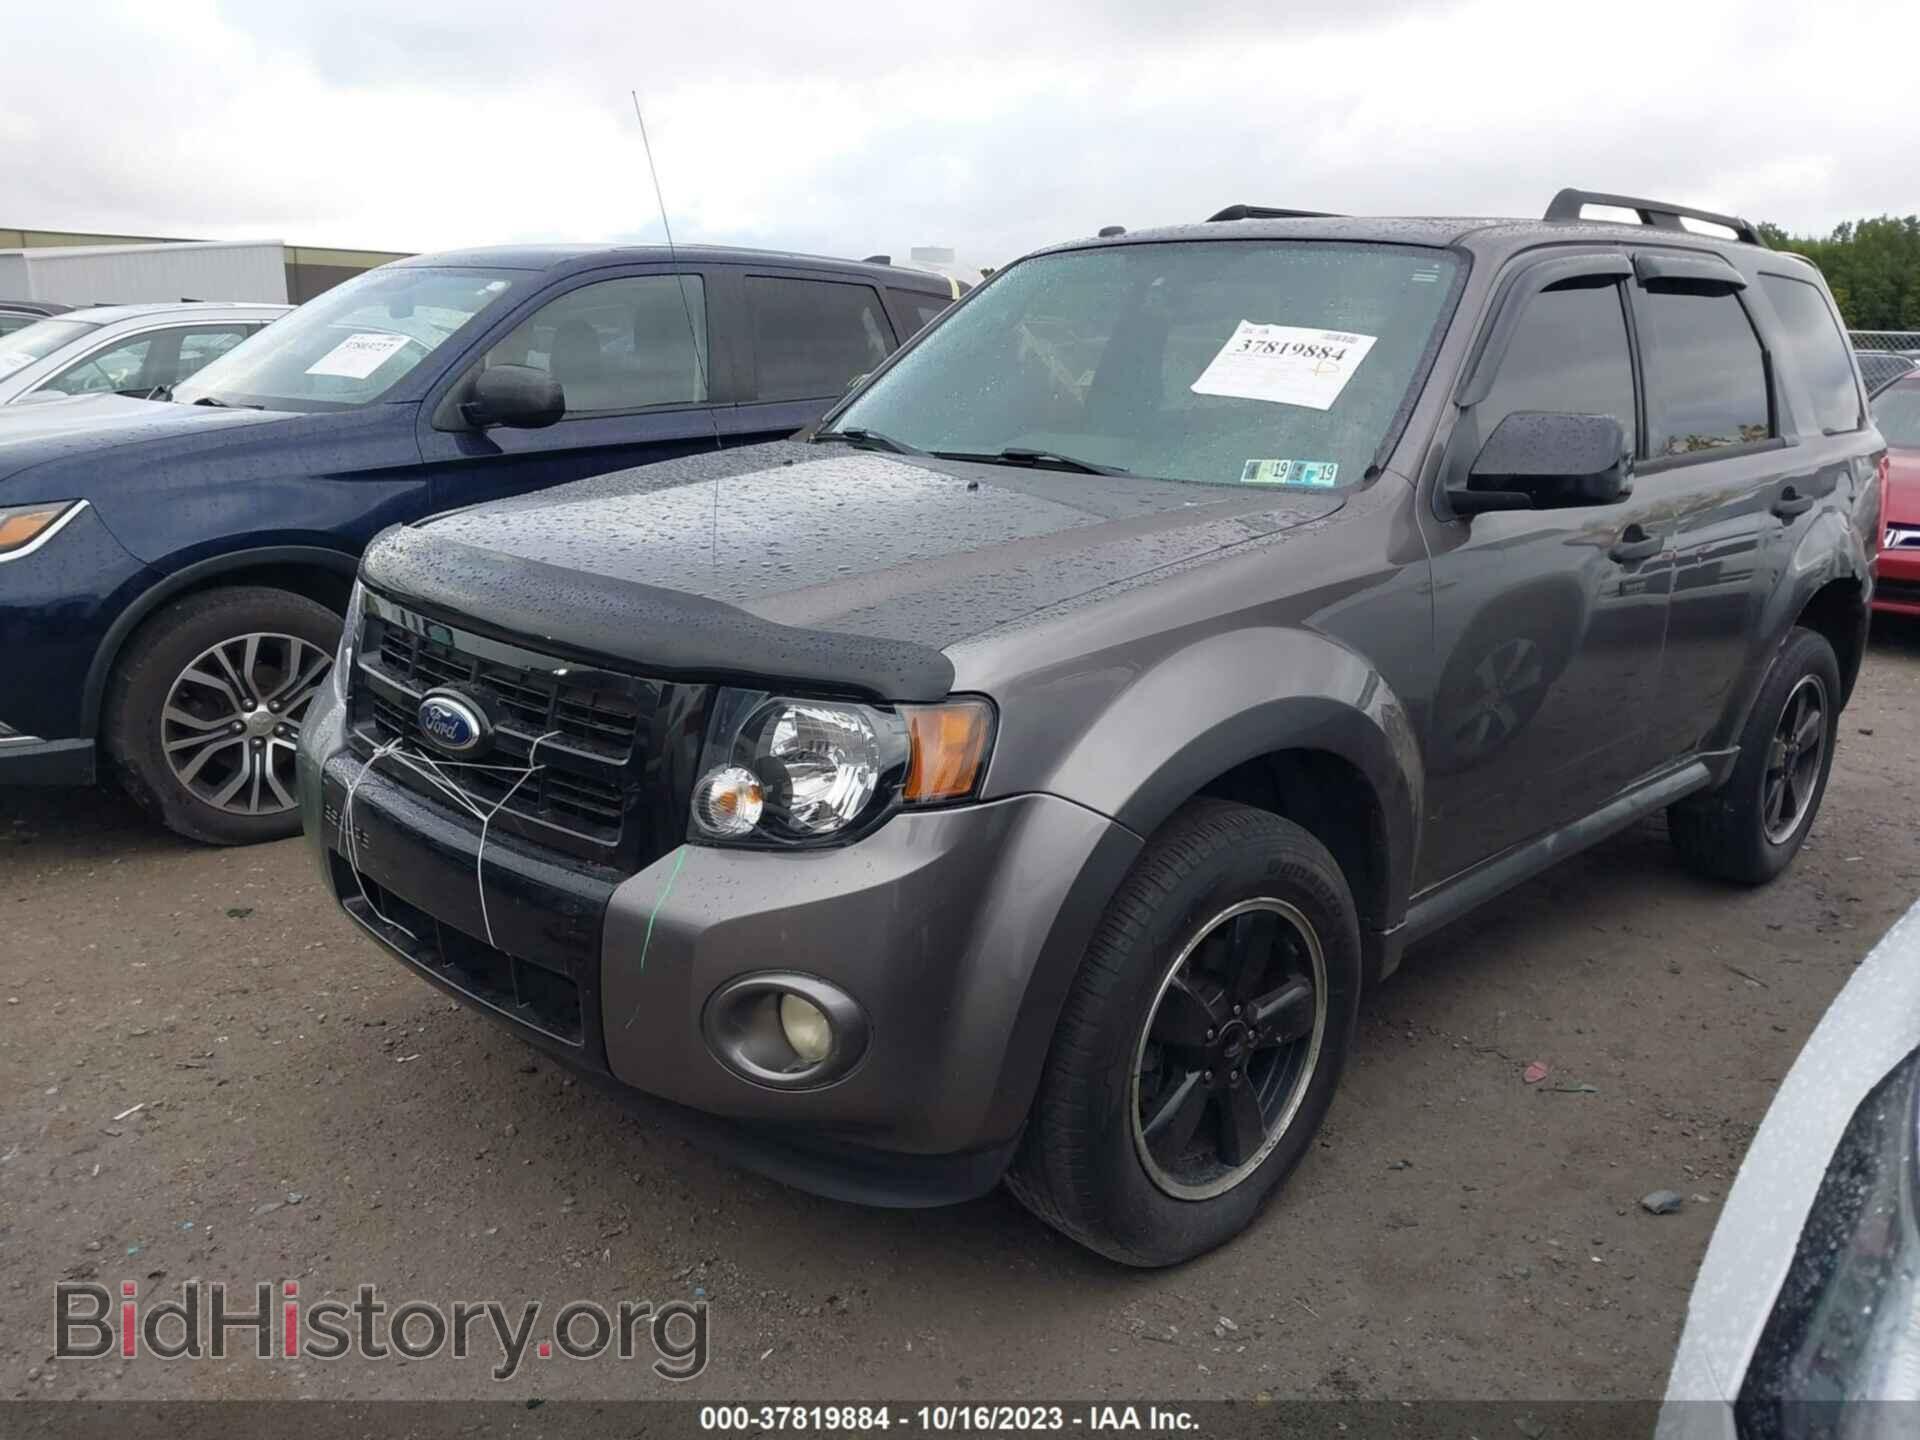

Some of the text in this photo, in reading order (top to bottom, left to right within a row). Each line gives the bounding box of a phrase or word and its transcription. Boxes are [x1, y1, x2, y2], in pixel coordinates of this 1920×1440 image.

[1235, 338, 1348, 361] 37819884
[1272, 462, 1288, 478] 19
[1319, 464, 1335, 481] 19
[425, 705, 459, 739] Ford
